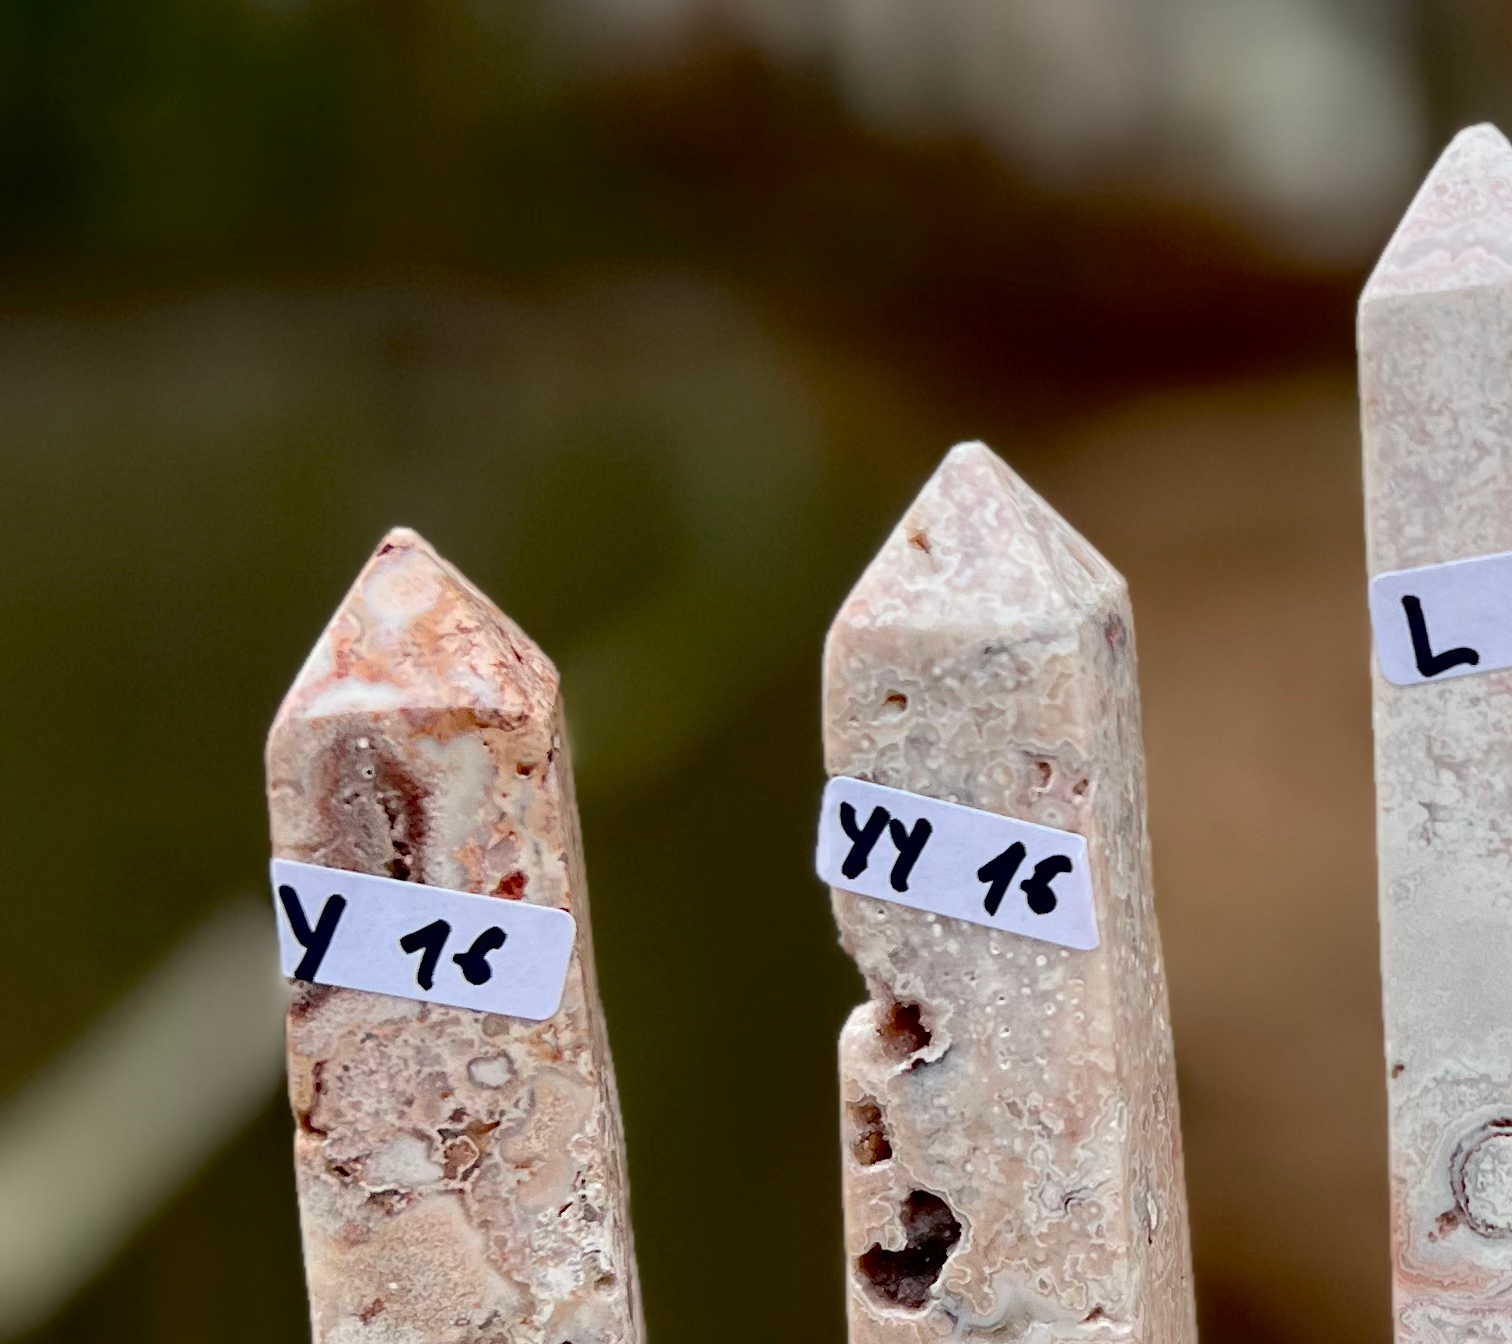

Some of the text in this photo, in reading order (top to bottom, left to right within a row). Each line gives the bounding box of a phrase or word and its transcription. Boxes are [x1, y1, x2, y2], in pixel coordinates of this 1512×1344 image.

[1402, 595, 1479, 677] L
[839, 801, 1073, 917] YY 16
[278, 884, 508, 991] Y 16
